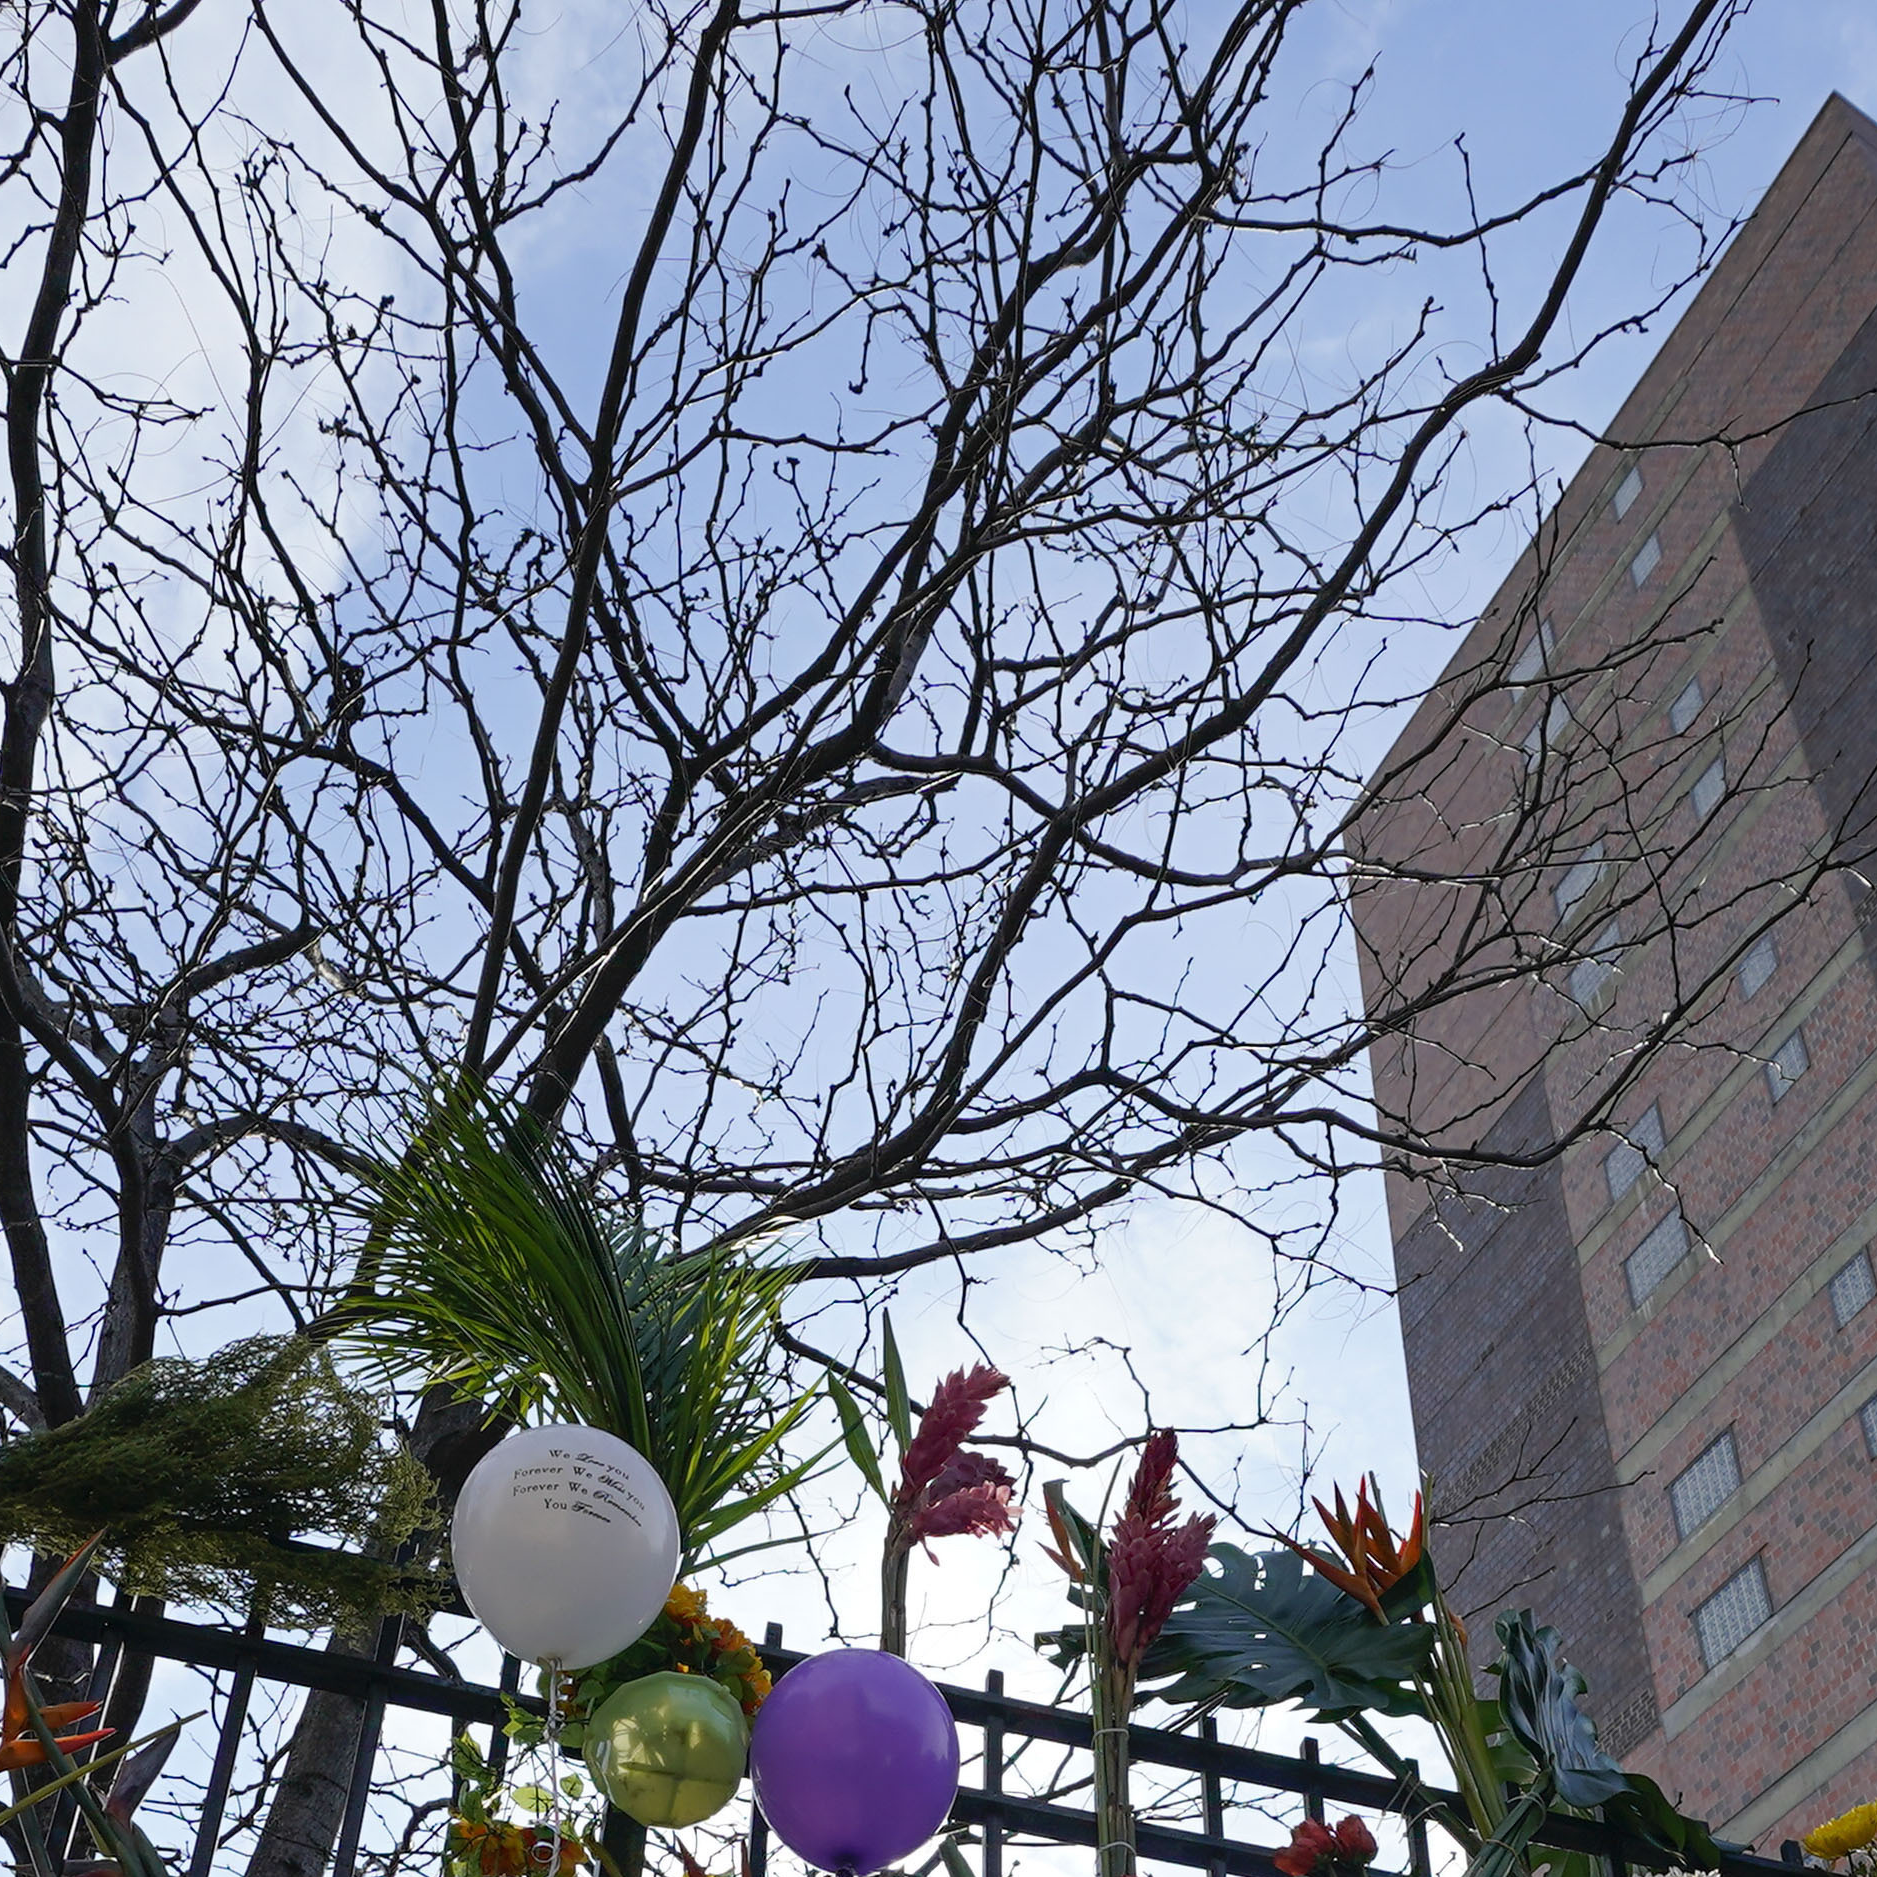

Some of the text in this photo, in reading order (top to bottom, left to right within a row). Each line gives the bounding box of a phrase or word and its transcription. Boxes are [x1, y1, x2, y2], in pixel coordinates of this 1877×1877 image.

[549, 1449, 570, 1459] We
[607, 1465, 629, 1480] you
[513, 1483, 560, 1496] Forever
[569, 1481, 588, 1495] We
[514, 1467, 563, 1480] Forever
[573, 1466, 593, 1479] We
[627, 1492, 645, 1510] you
[544, 1498, 567, 1510] You
